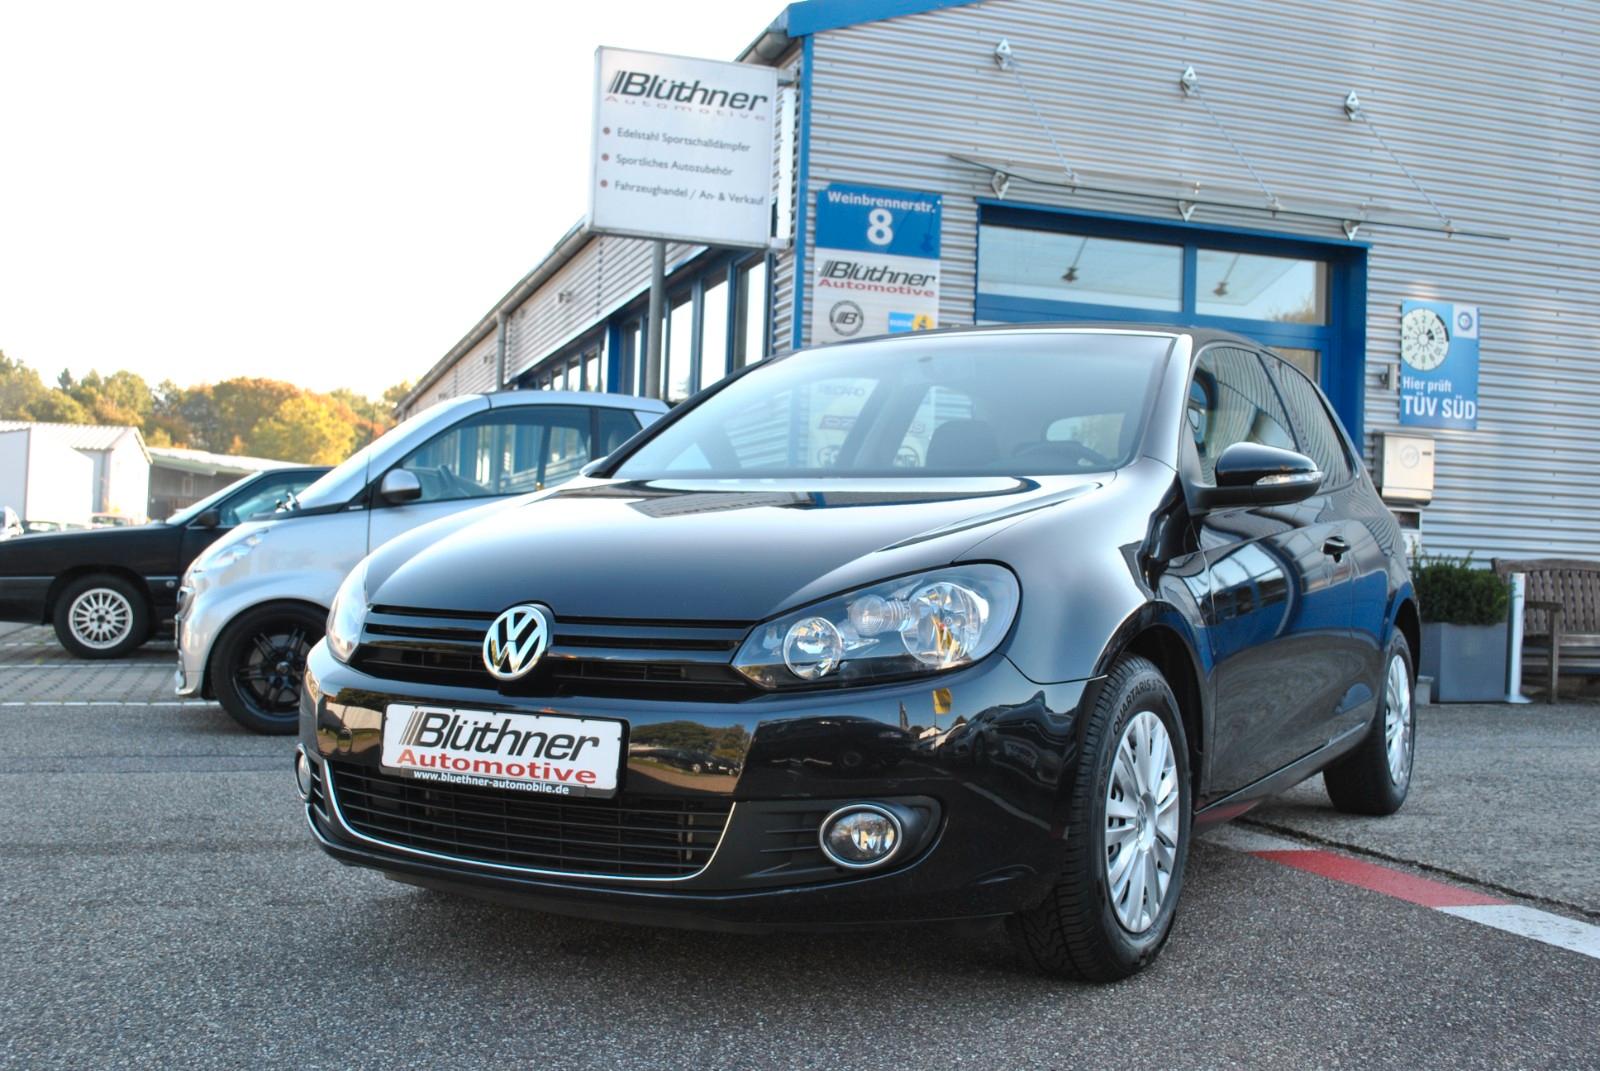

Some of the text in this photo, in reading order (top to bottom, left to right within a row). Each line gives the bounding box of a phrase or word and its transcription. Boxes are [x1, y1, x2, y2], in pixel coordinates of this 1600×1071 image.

[609, 70, 768, 111] Blüthner
[604, 95, 766, 121] Automotive
[617, 128, 751, 153] Edelstahl Sportschalldämpfer
[616, 154, 733, 176] Sportliches Autozubehör
[615, 181, 688, 197] Fahrzeughandel
[729, 193, 764, 205] Verkauf
[828, 191, 936, 213] Weinbrennerstr.
[867, 208, 894, 246] 8
[820, 260, 936, 287] Blüthner
[818, 278, 935, 298] Automotive
[1403, 376, 1452, 395] Hier prüft
[1403, 392, 1476, 420] TÜV SÜD
[399, 710, 600, 761] Blüthner
[396, 749, 597, 784] Automotive
[414, 770, 570, 795] www.bluethner-automobile.de
